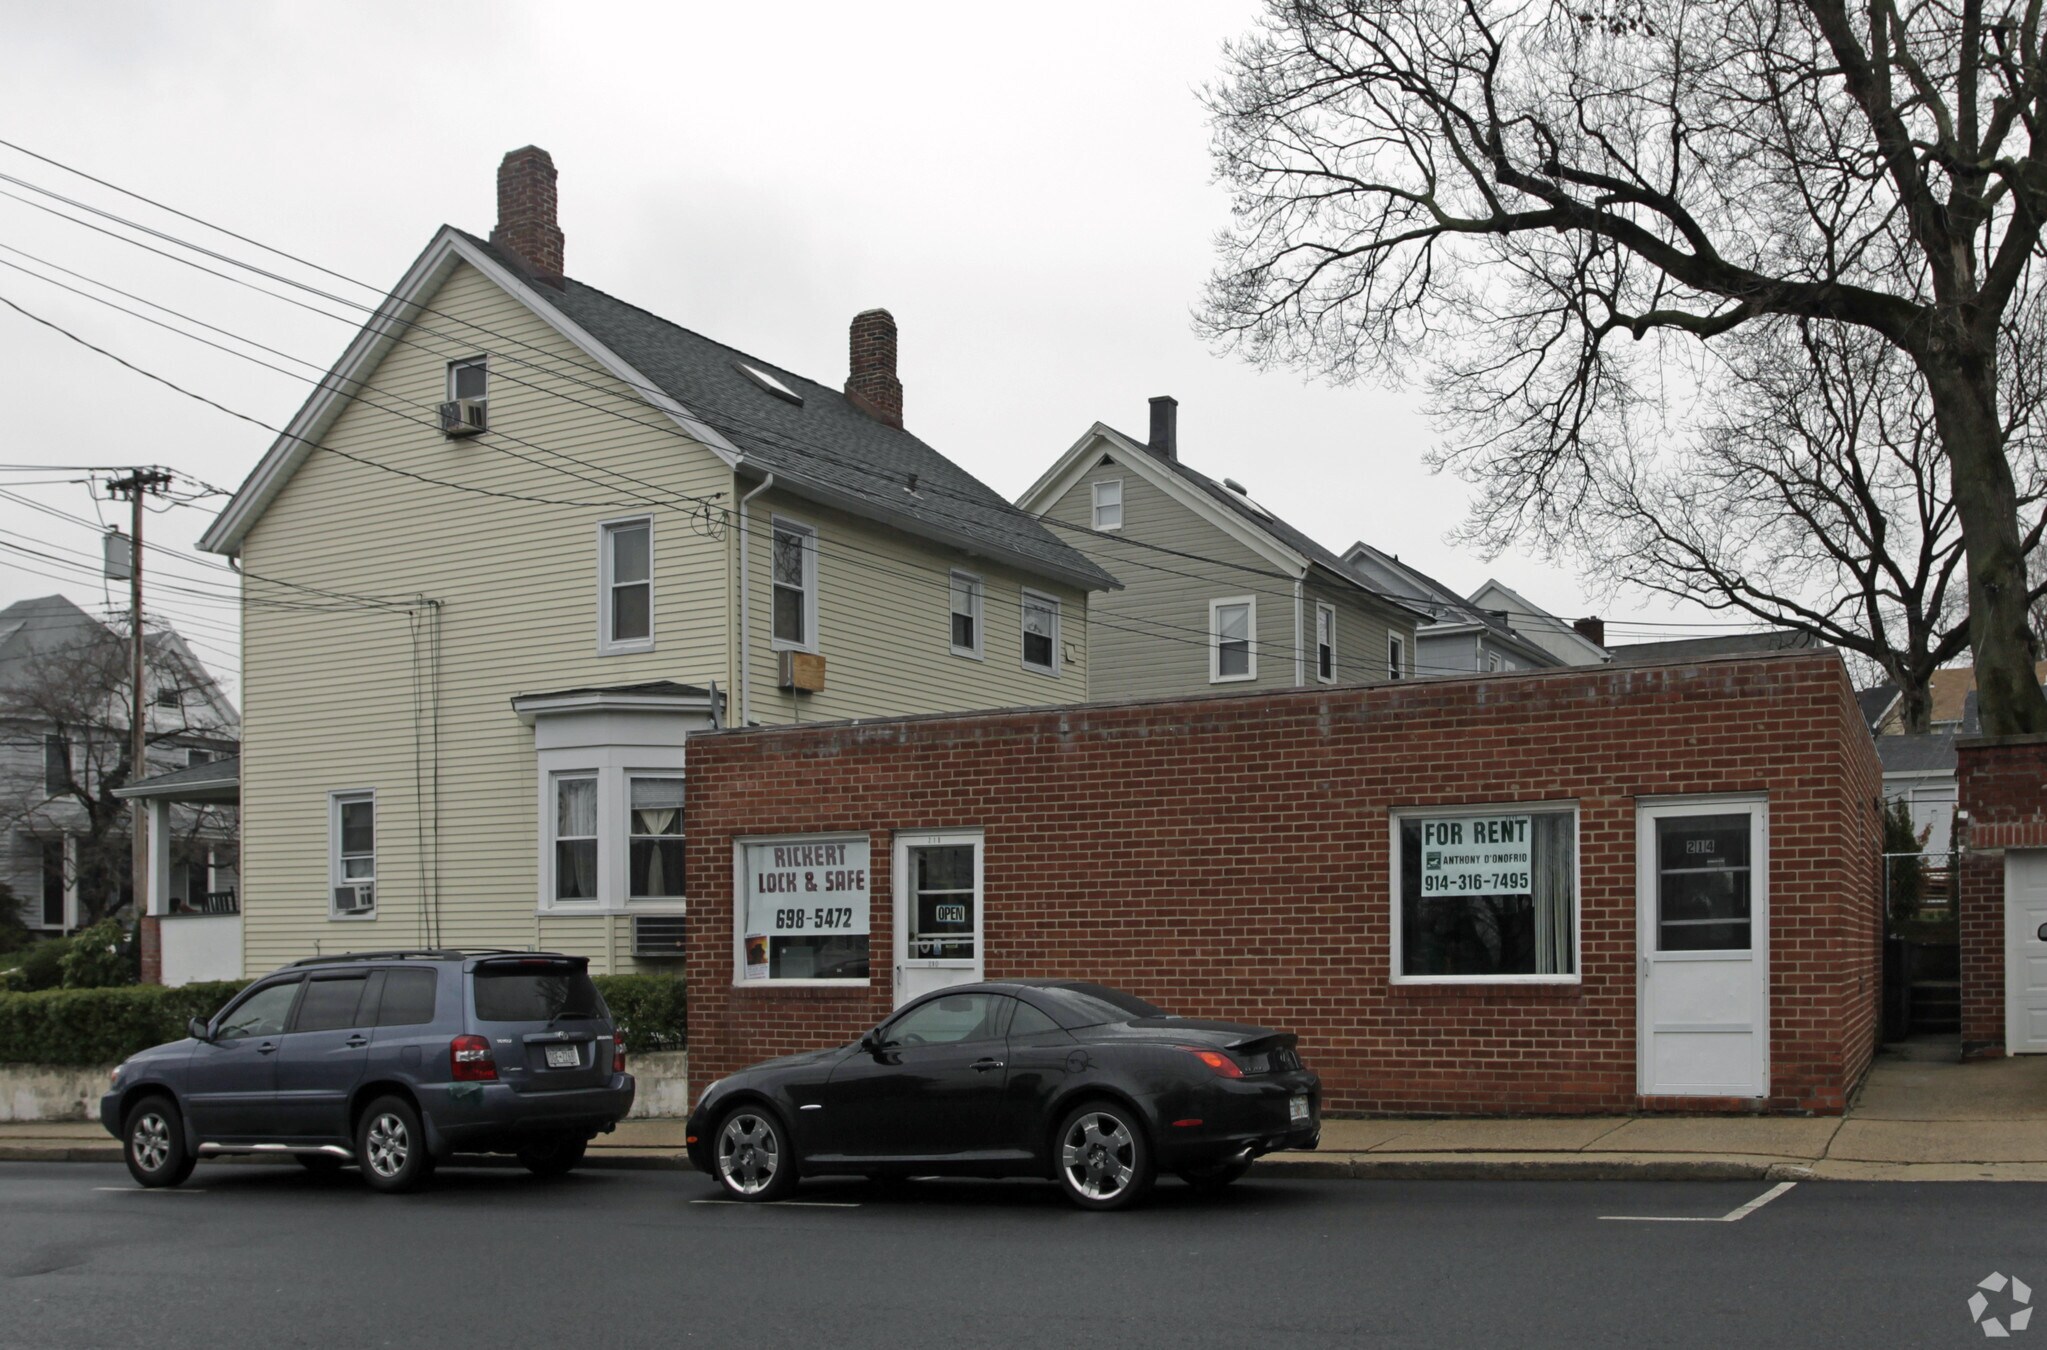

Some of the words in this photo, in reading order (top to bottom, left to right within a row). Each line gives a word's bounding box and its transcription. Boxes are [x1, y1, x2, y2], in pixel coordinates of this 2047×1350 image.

[1425, 822, 1463, 846] FOR
[1474, 819, 1528, 844] RENT
[773, 844, 847, 868] RICKERT
[1686, 840, 1715, 854] 214
[1443, 855, 1481, 865] ANTHONY
[1484, 853, 1528, 864] D'ONOFRIO
[758, 872, 797, 894] LOCK
[804, 871, 818, 892] &
[825, 869, 865, 892] SAFE
[1425, 872, 1529, 891] 914-316-7495
[776, 907, 853, 929] 698-5472
[938, 906, 963, 921] OPEN
